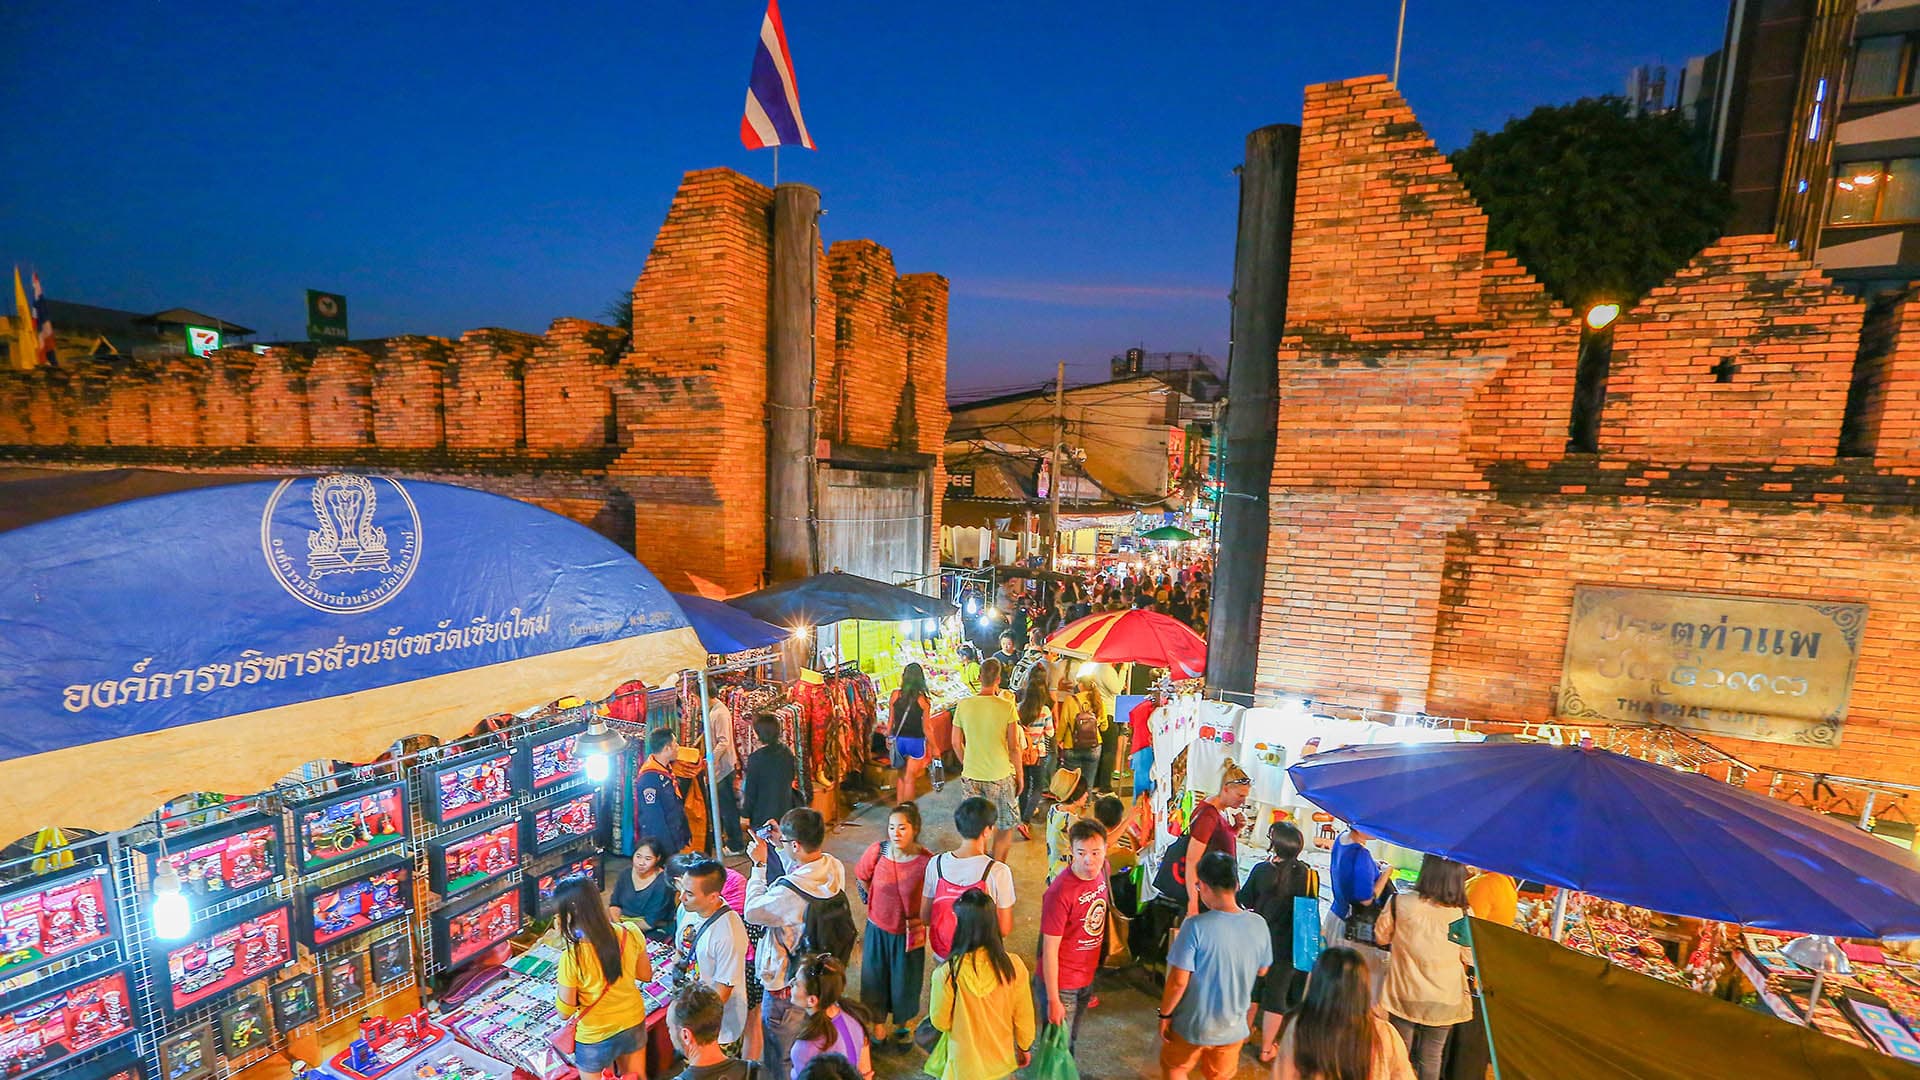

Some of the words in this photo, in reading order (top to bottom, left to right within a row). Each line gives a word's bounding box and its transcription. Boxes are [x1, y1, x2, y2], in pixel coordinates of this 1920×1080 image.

[272, 530, 415, 605] องค์การบริหารส่วนจังหวัดเชียงใหม่
[62, 607, 553, 713] องค์การบริหารส่วนจังหวัดเชียงใหม่
[1600, 614, 1822, 659] ประตูท่าแพ
[1617, 697, 1654, 714] THA
[1659, 701, 1712, 720] PHAE
